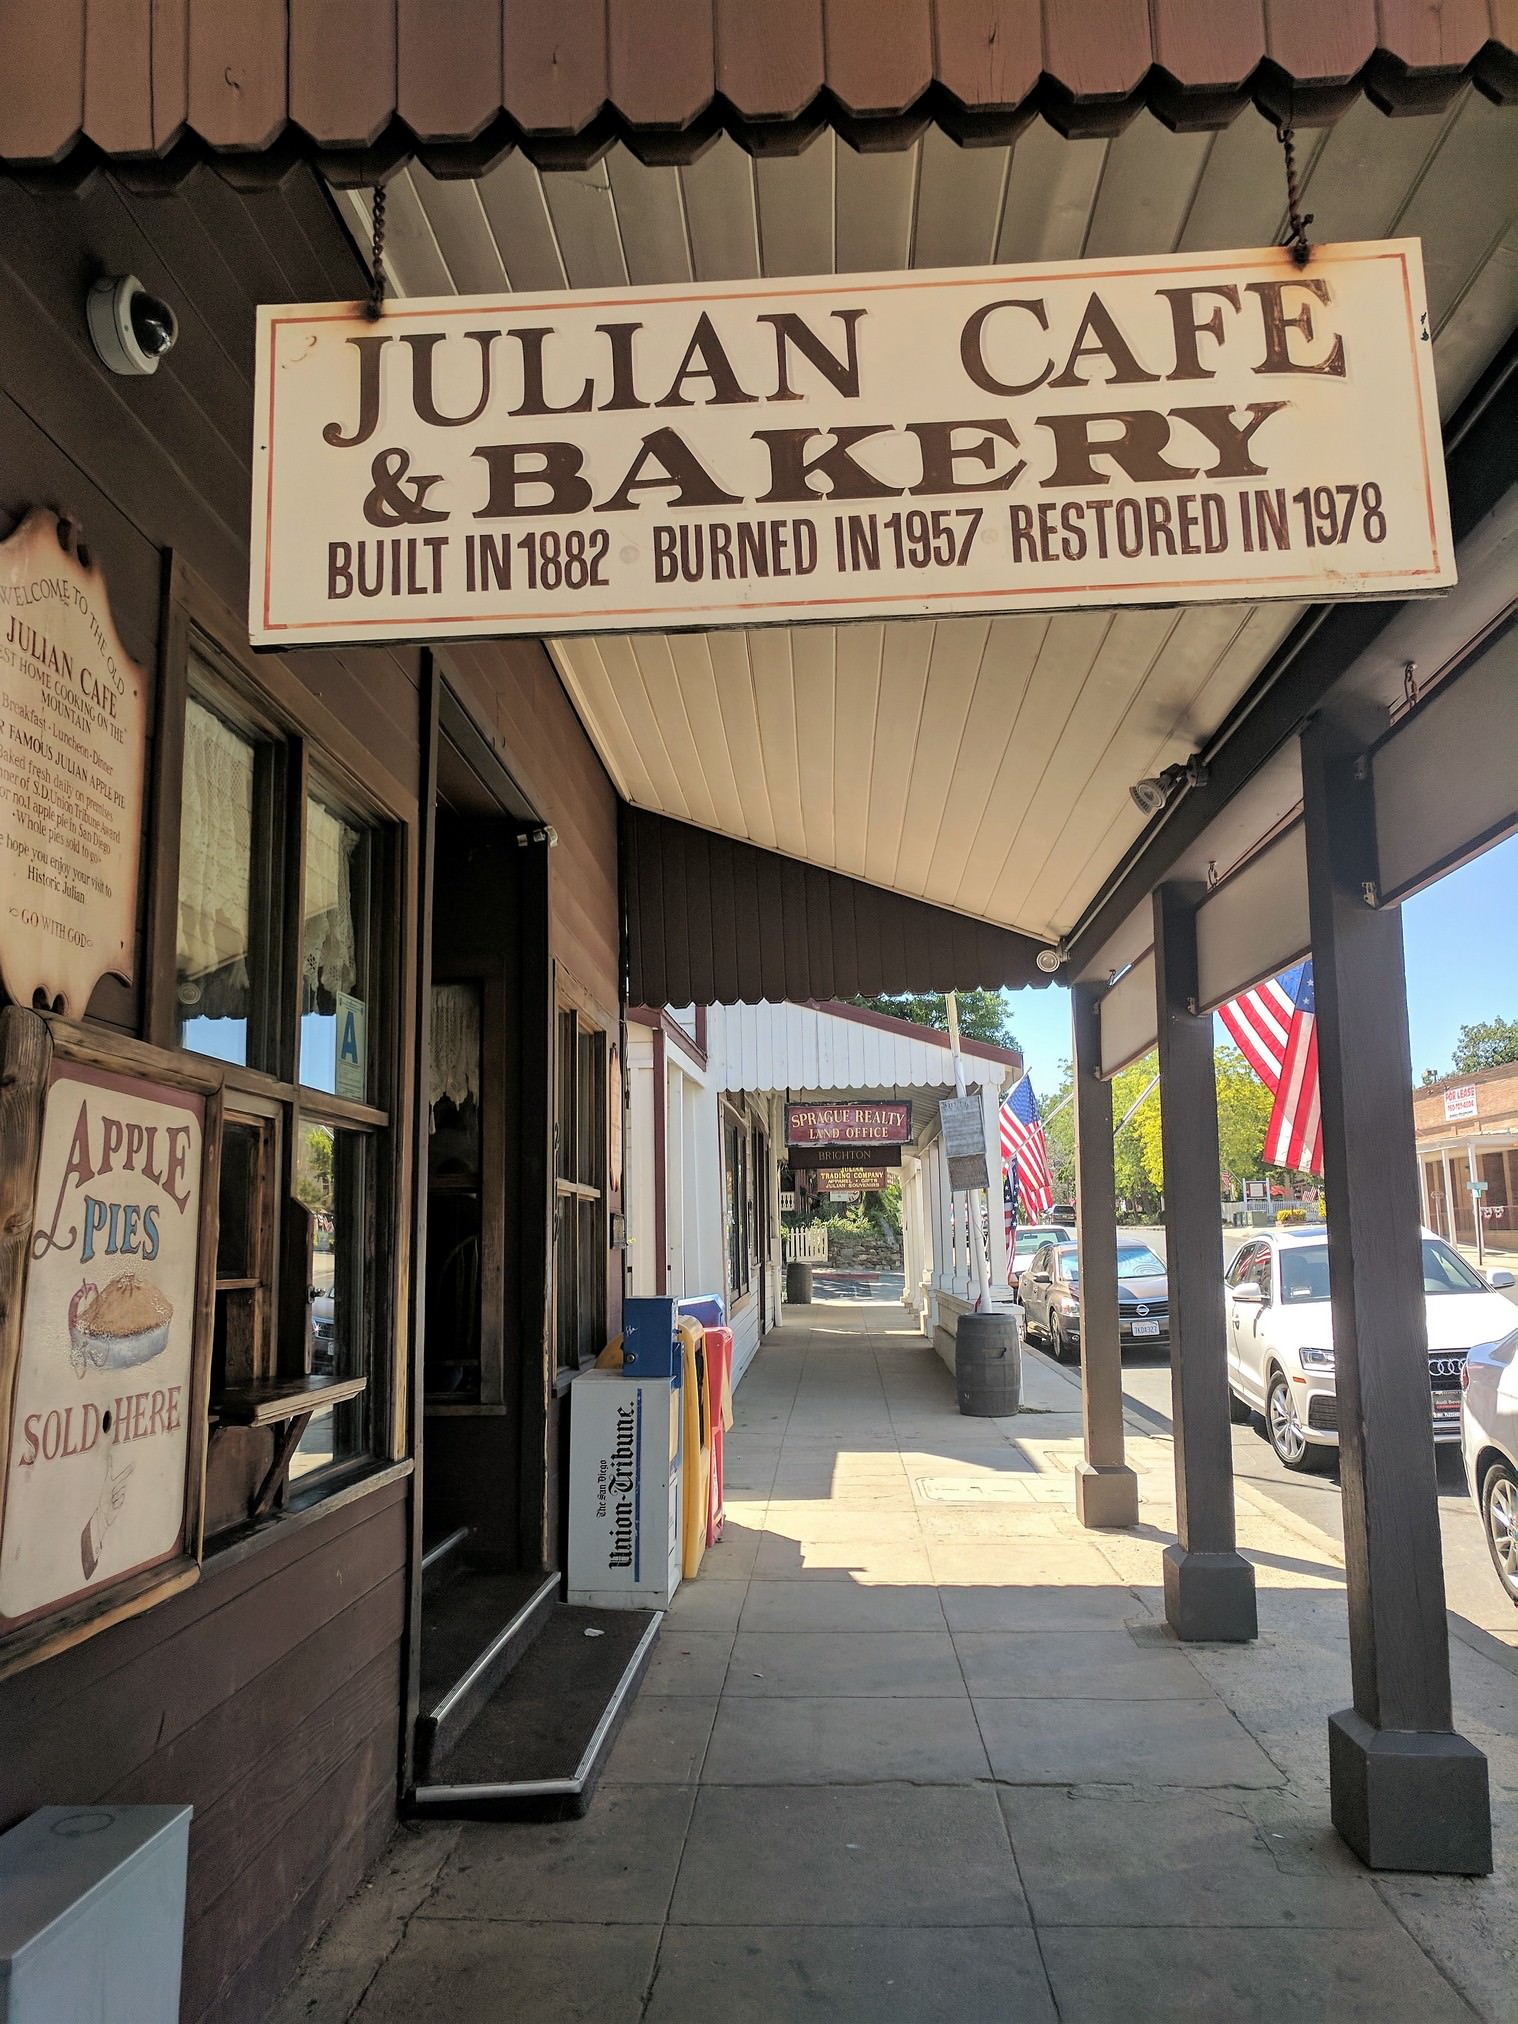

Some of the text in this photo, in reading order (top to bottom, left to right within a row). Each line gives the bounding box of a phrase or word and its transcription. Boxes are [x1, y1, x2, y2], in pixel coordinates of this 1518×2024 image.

[321, 278, 1347, 448] JULIAN CAFE
[362, 400, 1292, 528] & BAKERY
[327, 480, 1387, 600] BUILT IN 1882 BURNED IN 1957 RESTORED IN 1978
[0, 578, 125, 696] WELCOME TO THE OLD
[6, 614, 117, 720] JULIAN CAFE
[19, 656, 52, 690] HOME
[54, 680, 97, 722] COOKING
[97, 712, 109, 733] ON
[41, 688, 92, 735] MOUNTAIN
[2, 692, 114, 776] Breakfast Luncheon Dinner
[9, 723, 54, 761] FAMOUS
[55, 751, 88, 782] JULIAN
[89, 775, 113, 801] APPLE
[112, 790, 126, 809] PIE
[20, 777, 31, 791] of
[74, 803, 100, 830] Tribune
[100, 821, 120, 844] Award
[28, 760, 51, 784] fresh
[53, 773, 74, 799] daily
[75, 789, 85, 803] on
[86, 796, 114, 823] premises
[16, 808, 47, 836] Whole
[48, 827, 65, 845] pies
[66, 837, 80, 854] sold
[82, 844, 89, 858] to
[33, 801, 56, 821] apple
[79, 823, 92, 843] San
[92, 831, 111, 855] Diego
[6, 833, 30, 857] hope
[31, 847, 48, 865] you
[50, 857, 71, 879] enjoy
[72, 867, 91, 886] your
[91, 877, 105, 894] visit
[105, 884, 112, 899] to
[27, 864, 85, 904] Historic Julian
[21, 908, 87, 948] GO WITH GOD
[341, 1011, 358, 1065] A
[791, 1109, 905, 1128] SPRAGUE REALTY
[1457, 1086, 1475, 1100] LEASE
[809, 1126, 889, 1140] LAND OFFICE
[818, 1150, 871, 1161] BRIGHTON
[31, 1098, 191, 1260] APPLE
[820, 1172, 851, 1180] TRADING
[853, 1171, 884, 1179] COMPANY
[80, 1194, 160, 1264] PIES
[18, 1384, 182, 1467] SOLD HERE
[596, 1459, 608, 1518] The San Diego
